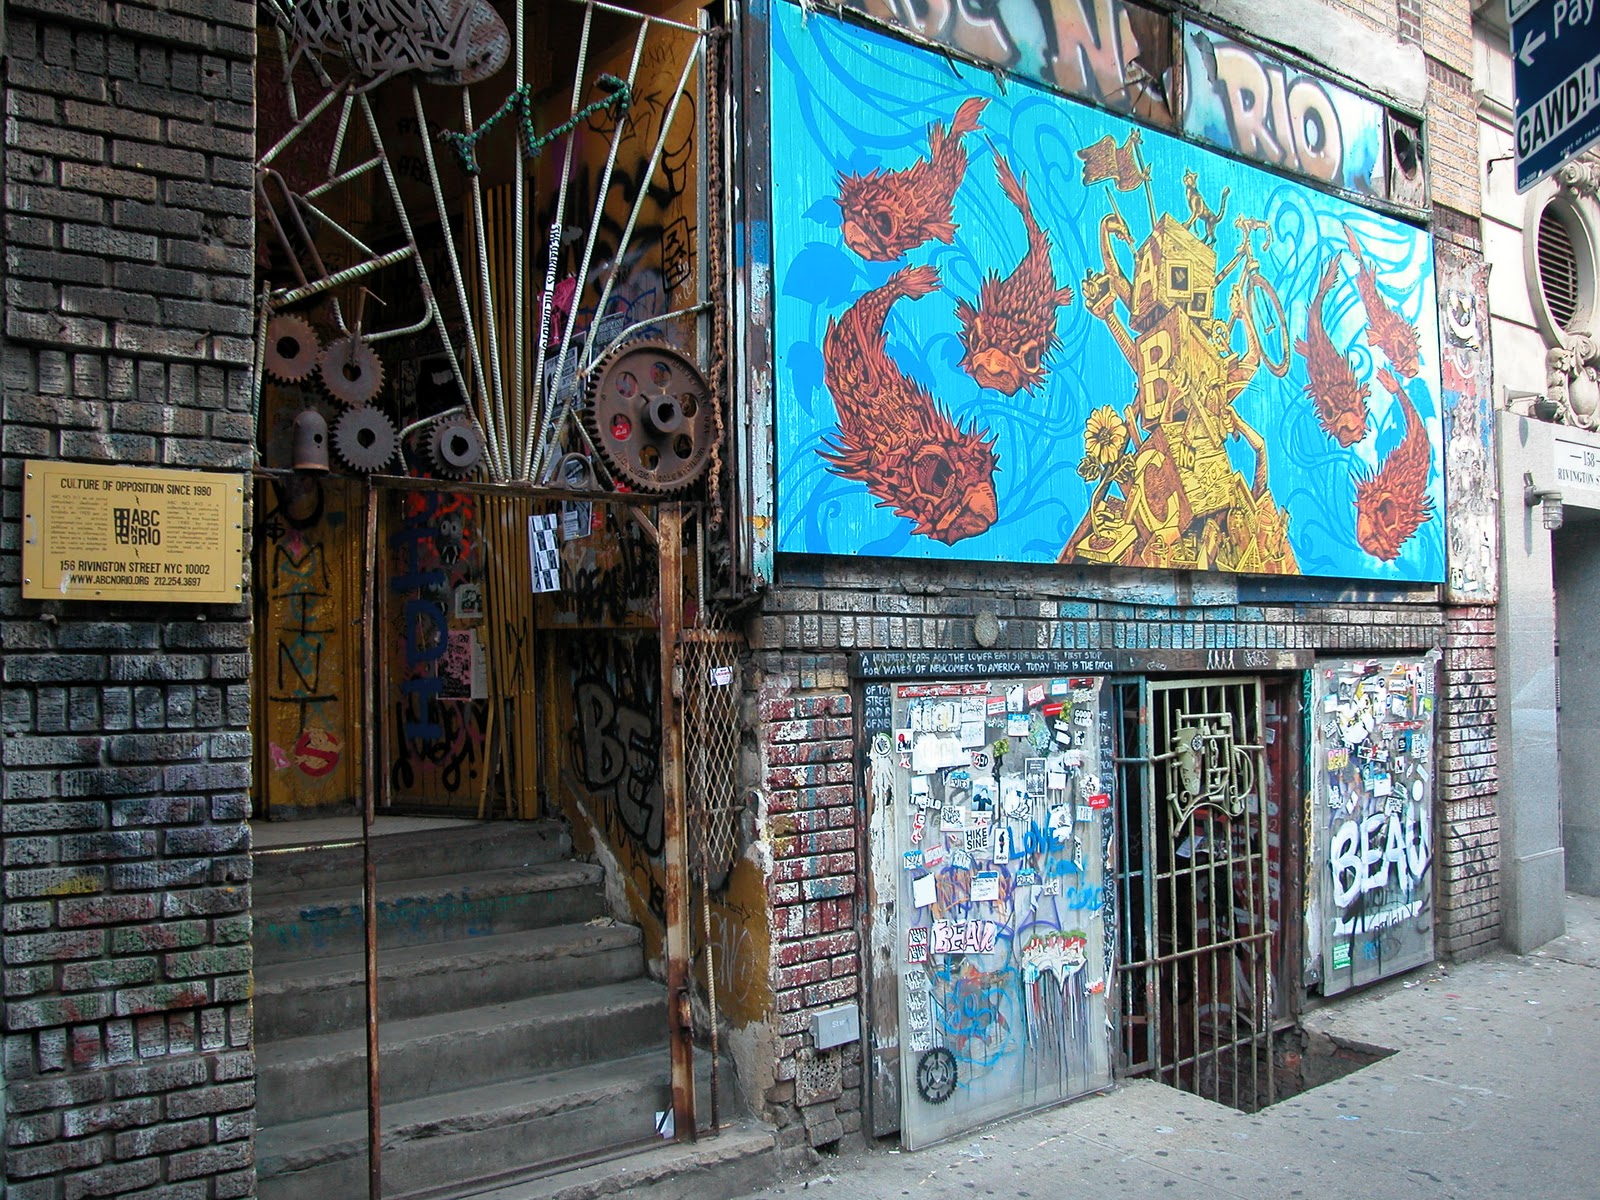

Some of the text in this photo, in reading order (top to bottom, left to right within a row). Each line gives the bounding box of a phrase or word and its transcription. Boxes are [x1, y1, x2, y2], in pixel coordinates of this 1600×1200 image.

[1212, 40, 1344, 182] RIO
[1583, 451, 1595, 467] 158
[1558, 467, 1594, 483] RIVINGTON
[61, 478, 211, 496] CULTURE OF OPPOSITION SINCE 1980
[132, 509, 160, 527] ABC
[138, 527, 161, 545] RIO
[60, 560, 210, 575] 156 RIVINGTON STREET NYC 10002
[69, 574, 149, 585] WWW.ABCNORIO.ORG
[949, 653, 964, 662] THE
[1013, 652, 1029, 660] SIDE
[1064, 652, 1082, 660] FIRST
[884, 666, 911, 674] WAVES
[916, 665, 926, 673] OF
[930, 663, 974, 673] NEWCOMERS
[977, 664, 987, 673] TO
[1053, 661, 1068, 672] THIS
[1080, 661, 1094, 670] THE
[1095, 661, 1113, 670] PATCH
[866, 685, 875, 695] OF
[865, 707, 882, 717] AND
[866, 718, 877, 728] OF
[965, 828, 987, 840] HIKE
[966, 837, 987, 850] SINE
